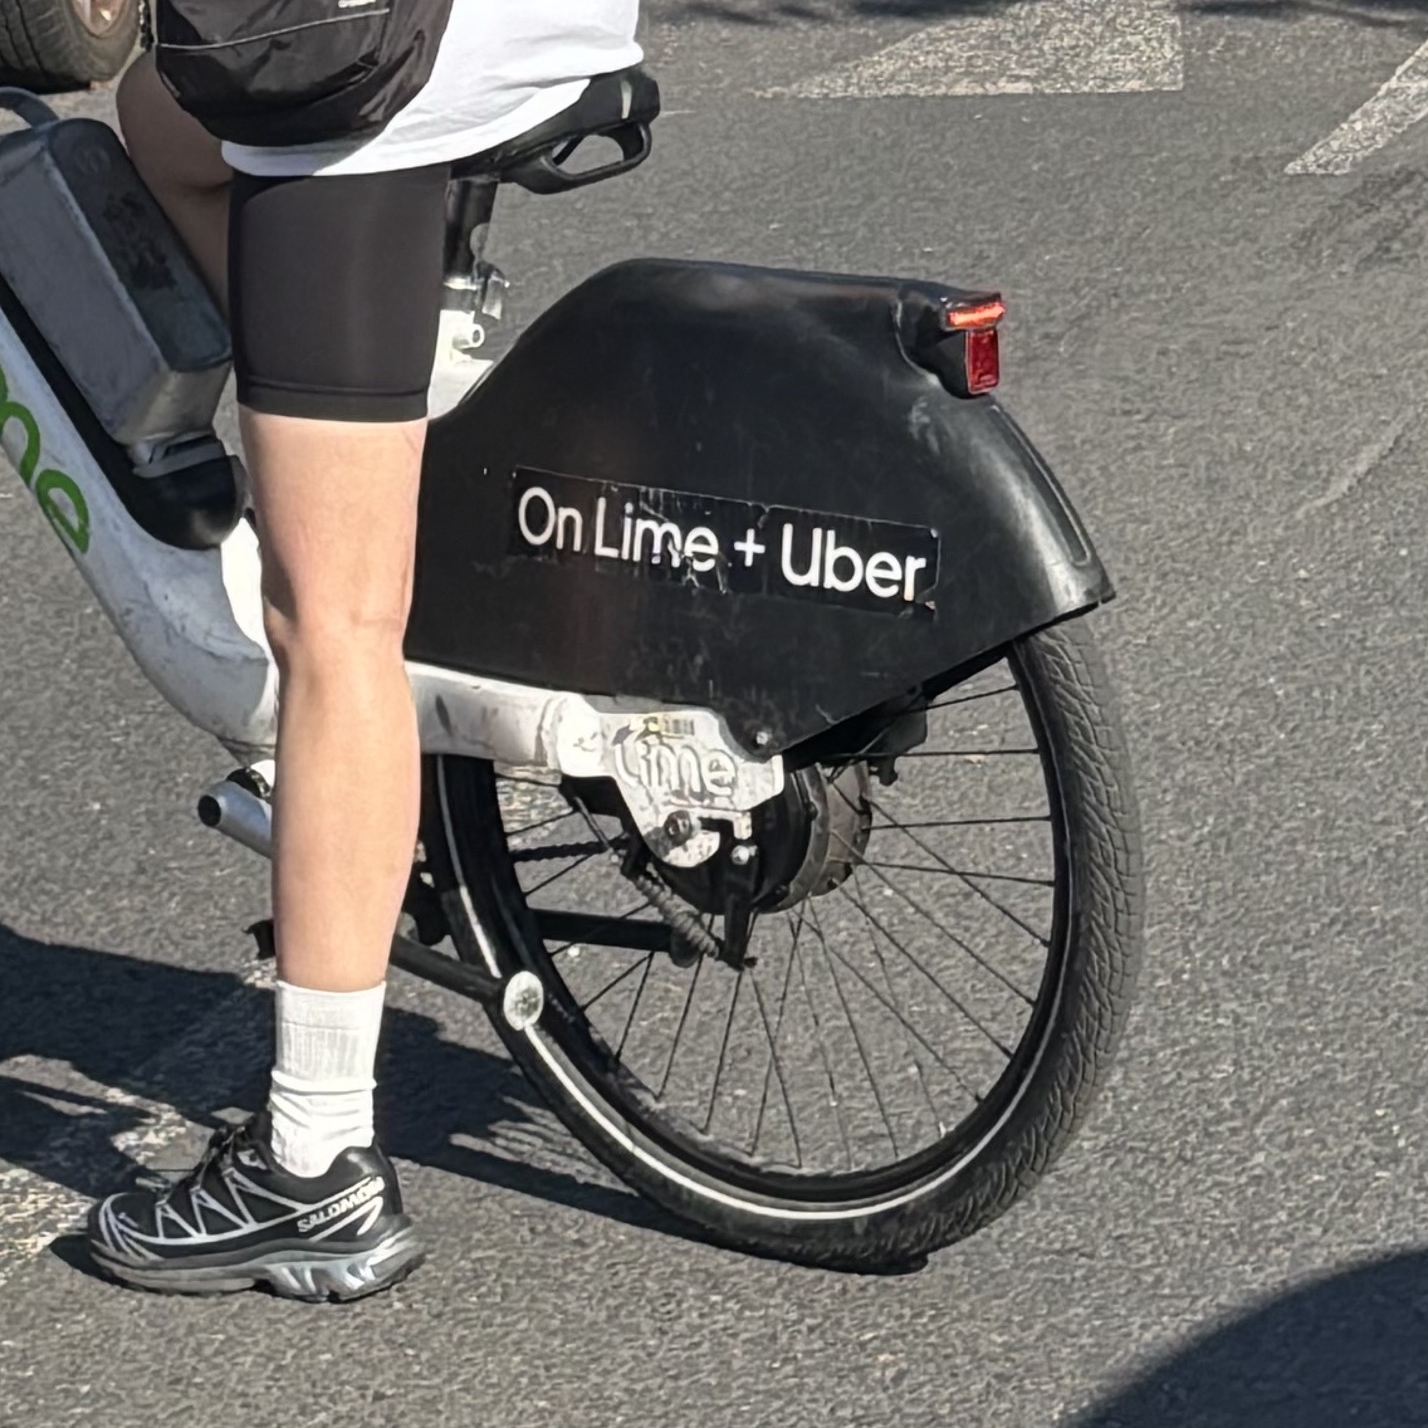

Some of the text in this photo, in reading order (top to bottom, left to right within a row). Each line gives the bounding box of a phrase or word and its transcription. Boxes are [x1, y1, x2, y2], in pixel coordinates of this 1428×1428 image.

[518, 486, 583, 551] On
[594, 495, 719, 573] Lime
[781, 522, 927, 603] Uber
[297, 1175, 386, 1233] SALOMON
